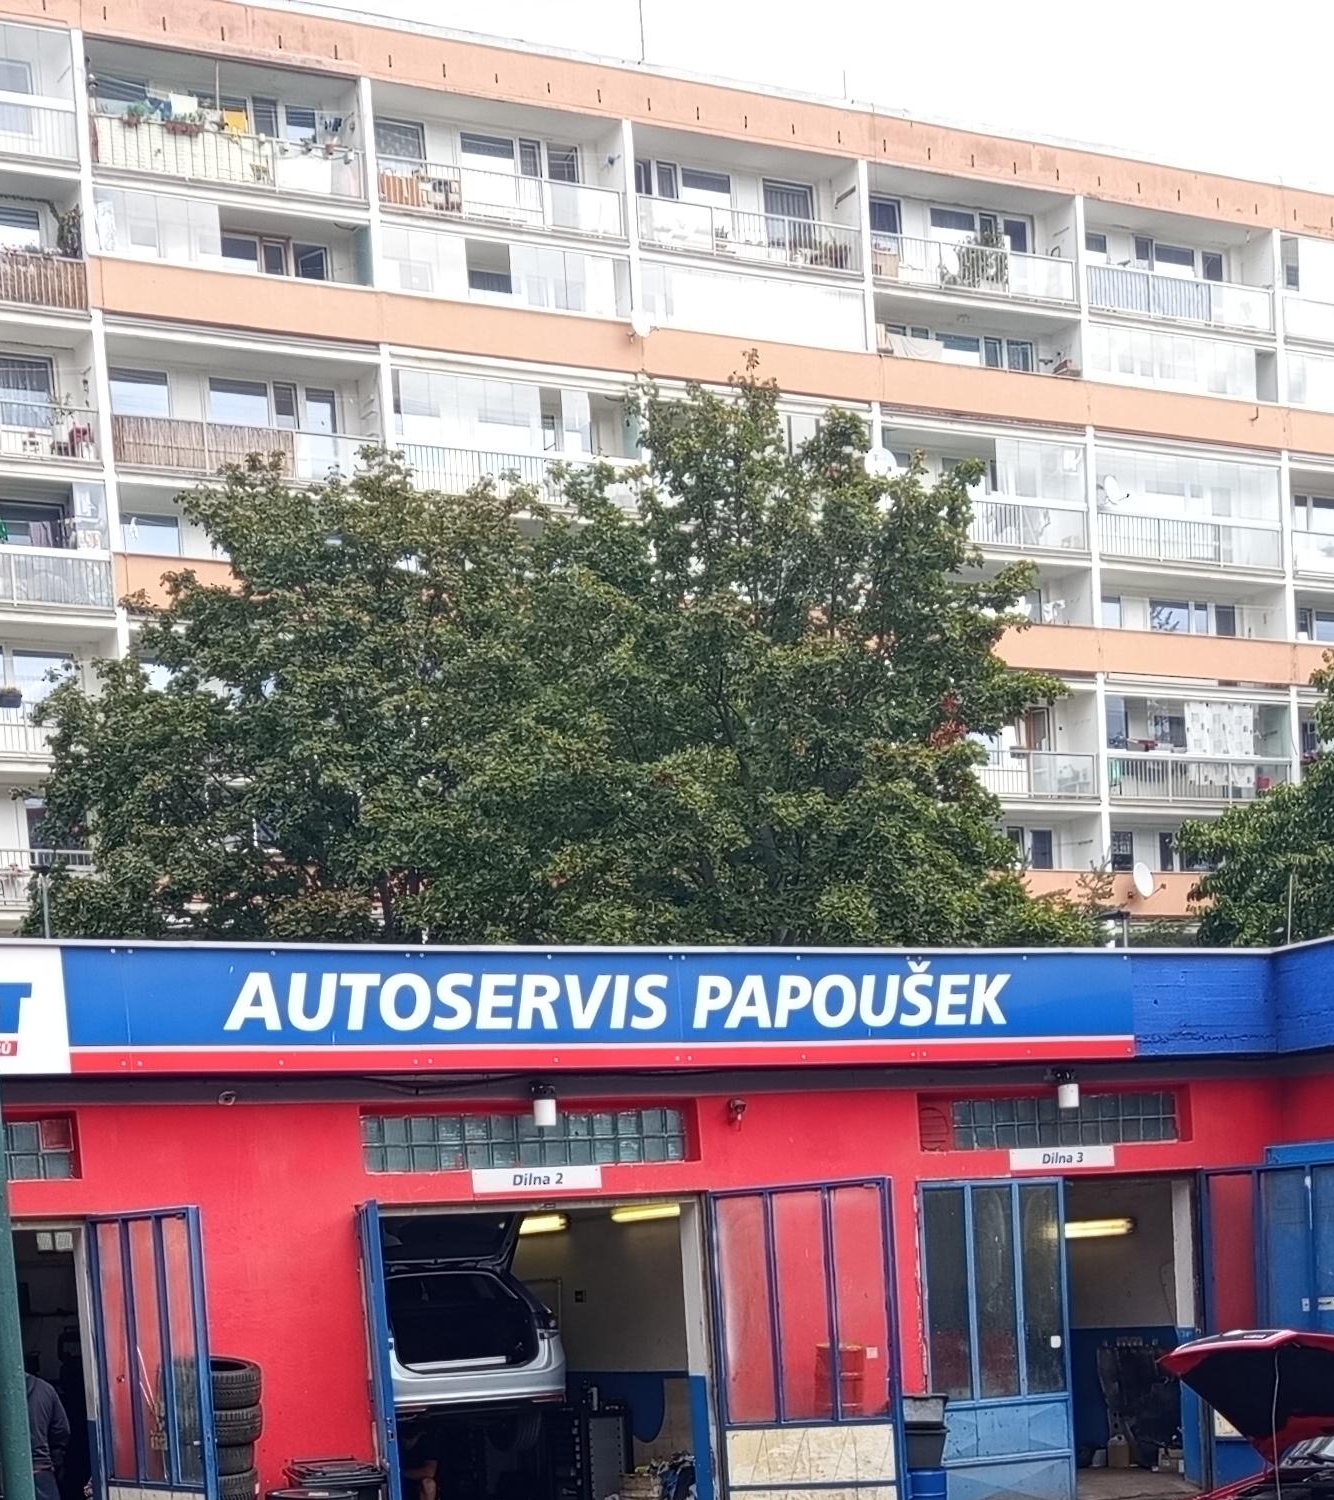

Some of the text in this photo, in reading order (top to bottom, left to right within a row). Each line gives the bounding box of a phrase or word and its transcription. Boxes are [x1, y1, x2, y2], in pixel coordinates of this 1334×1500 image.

[225, 961, 1011, 1031] AUTOSERVIS PAPOUŠEK
[1076, 1151, 1084, 1163] 3
[555, 1172, 564, 1185] 2
